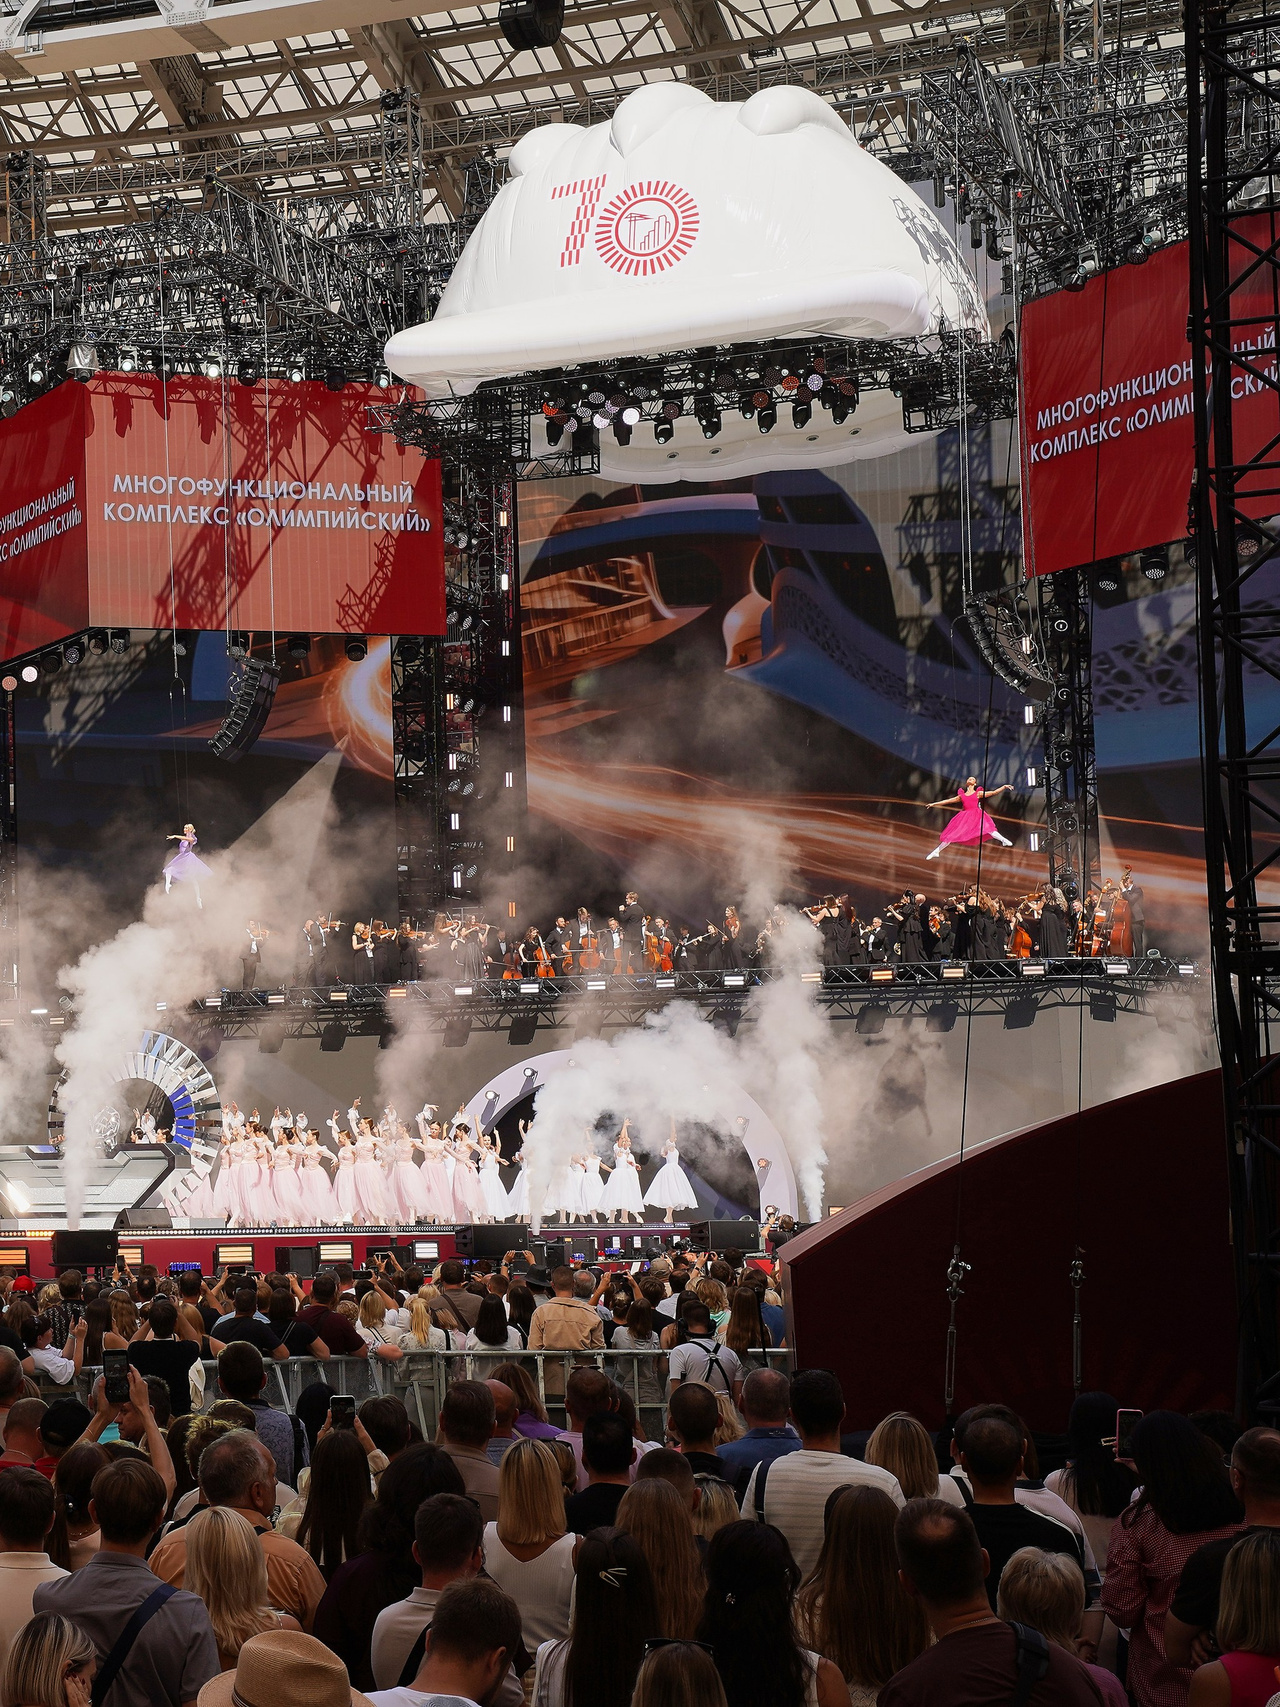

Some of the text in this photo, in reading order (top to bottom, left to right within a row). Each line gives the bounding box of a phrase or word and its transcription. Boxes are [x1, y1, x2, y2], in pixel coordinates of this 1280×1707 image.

[1037, 326, 1276, 431] МНОГОФУНКЦИОННЫЙ
[1030, 416, 1122, 463] КОМПЛЕКС
[113, 474, 414, 503] МНОГОФУНКЦИОНАЛЬНЫЙ
[10, 503, 82, 557] «ОЛИМПИЙСКИЙ»
[103, 502, 431, 532] КОМПЛЕКС «ОЛИМПИЙСКИЙ»
